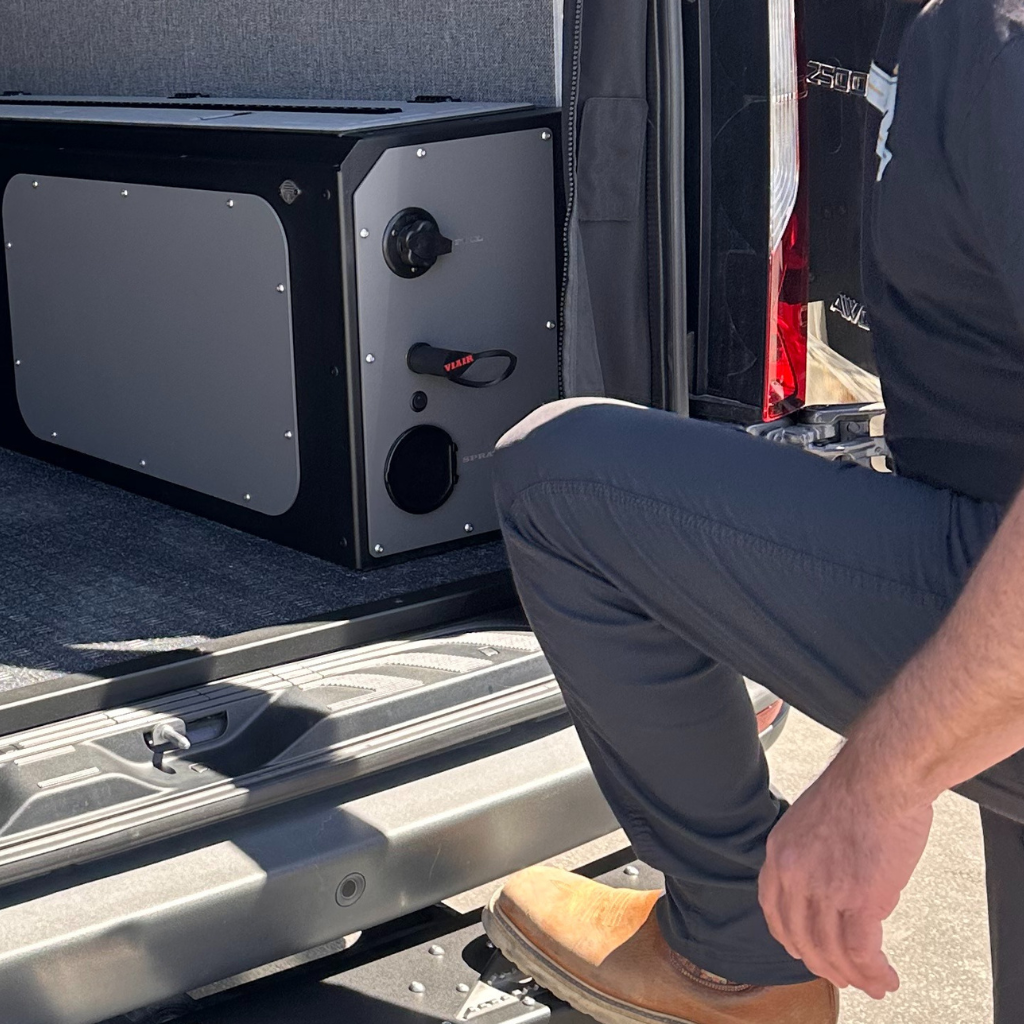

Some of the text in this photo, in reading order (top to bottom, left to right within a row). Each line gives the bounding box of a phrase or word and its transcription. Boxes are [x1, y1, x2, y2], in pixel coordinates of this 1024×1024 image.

[806, 60, 869, 97] 2500
[443, 354, 474, 372] VIAIR
[462, 451, 495, 464] SPRA
